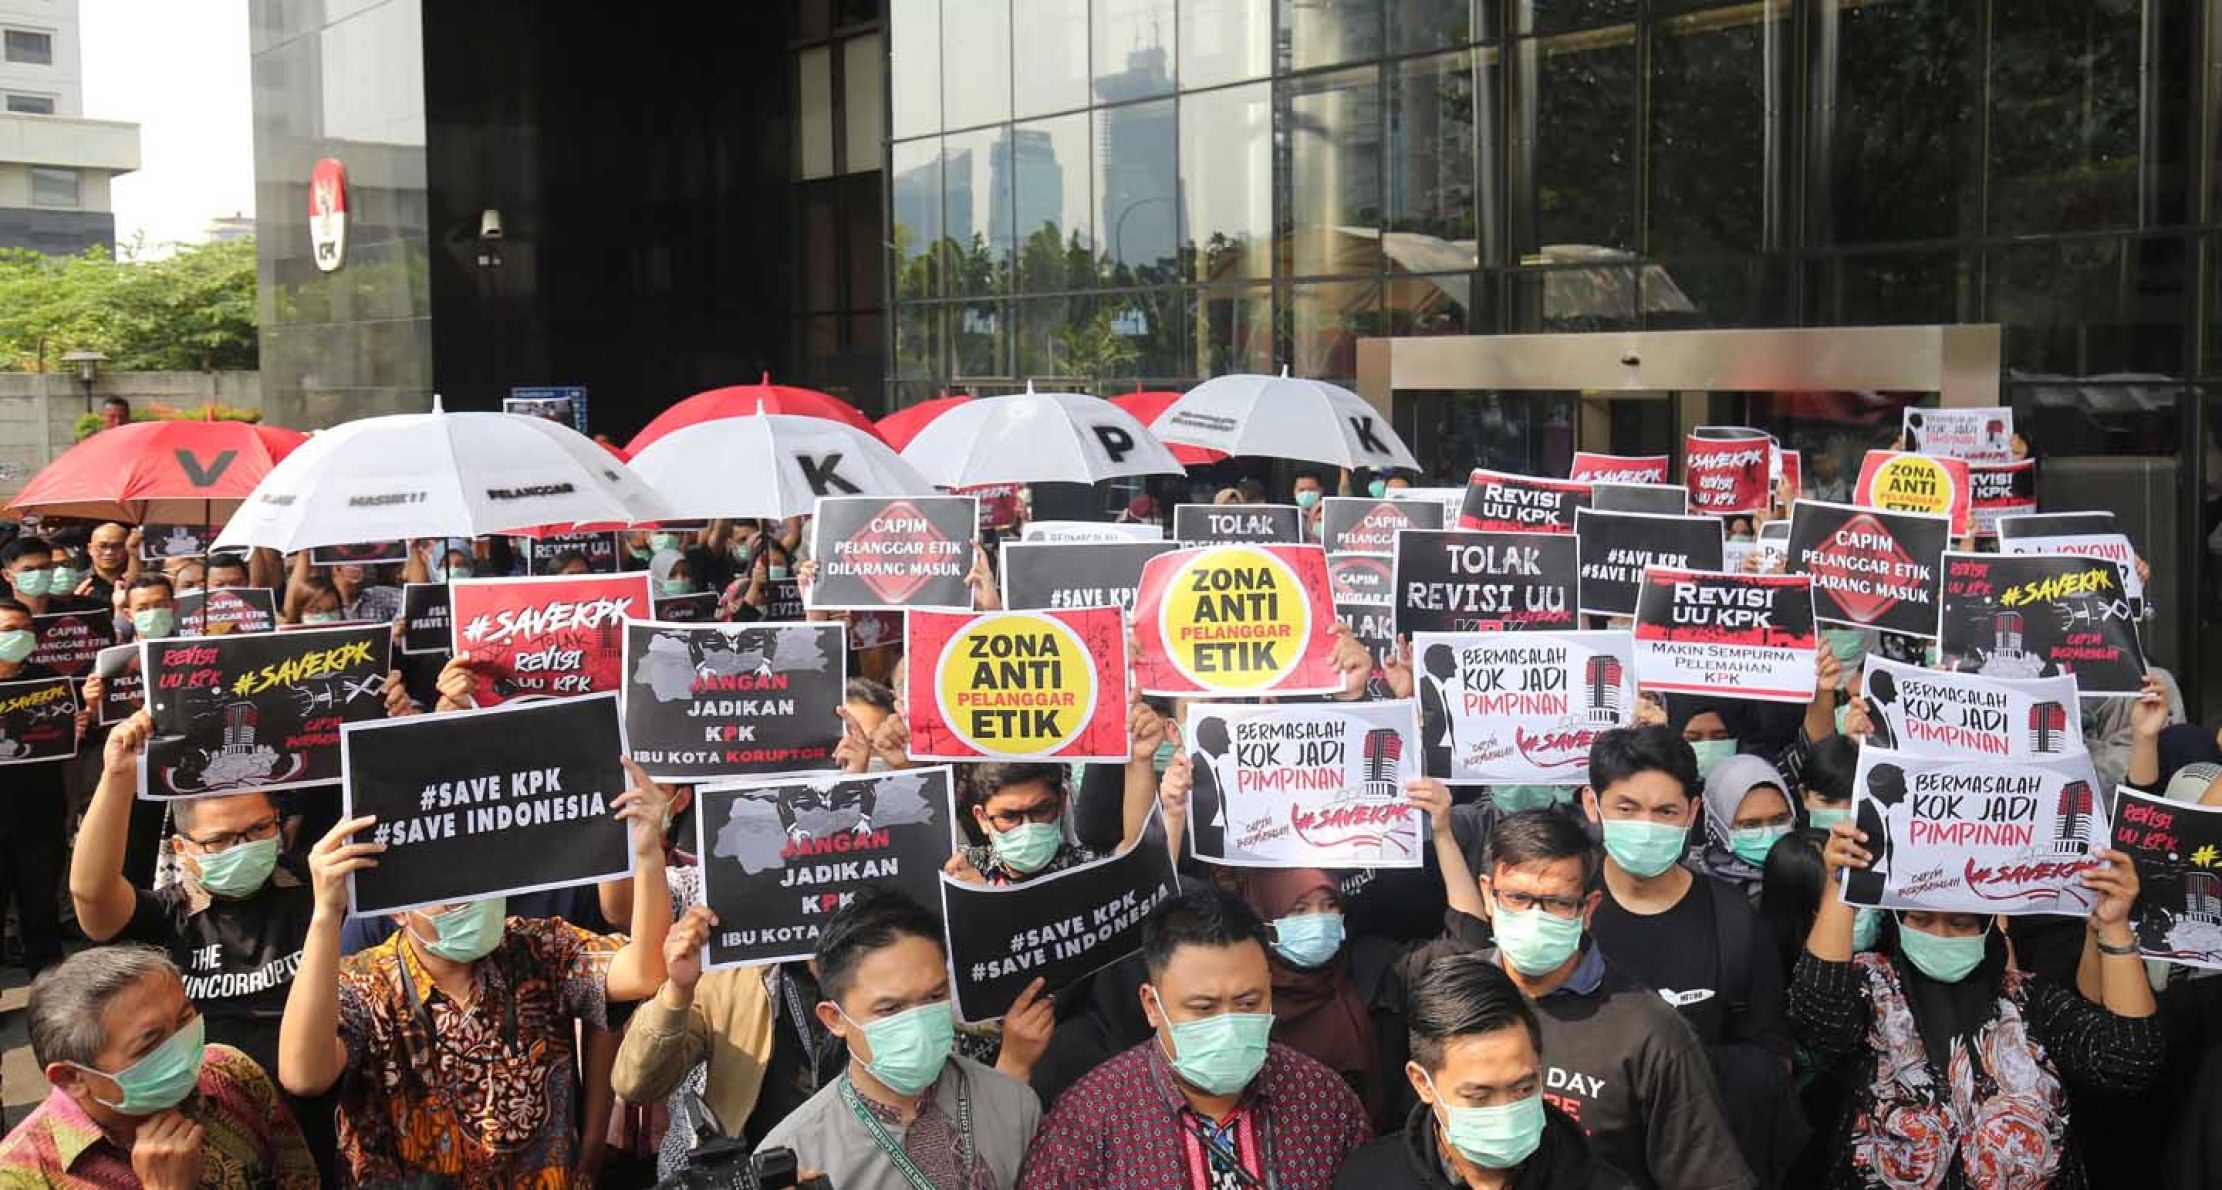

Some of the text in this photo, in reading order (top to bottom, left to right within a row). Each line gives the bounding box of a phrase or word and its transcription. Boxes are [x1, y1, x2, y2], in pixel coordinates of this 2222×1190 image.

[1091, 425, 1135, 464] P
[1349, 416, 1393, 457] K
[174, 449, 239, 487] V
[796, 453, 864, 497] K
[1890, 465, 1936, 481] ZONA
[1485, 483, 1562, 509] REVISI
[1889, 480, 1937, 496] ANTI
[871, 517, 928, 534] CAPIM
[1208, 515, 1274, 534] TOLAK
[1364, 517, 1408, 529] CAPIM
[1483, 503, 1561, 525] UU KPK
[834, 540, 962, 556] PELANGGAR ETIK
[1835, 530, 1893, 552] CAPIM
[827, 561, 962, 577] DILARANG MASUK
[1446, 543, 1543, 576] TOLAK
[1607, 548, 1688, 569] #SAVE KPK
[1801, 549, 1890, 575] PELANGGAR
[1894, 563, 1931, 581] ETIK
[1192, 567, 1276, 592] ZONA
[1339, 572, 1380, 585] CAPIM
[1581, 564, 1633, 583] #SAVE
[1050, 588, 1103, 607] #SAVE
[1406, 581, 1565, 613] REVISI UU
[1674, 582, 1776, 609] REVISI
[1875, 582, 1930, 604] MASUK
[2000, 567, 2115, 607] #SAVEKPK
[462, 595, 634, 644] #SAVEKPK
[1193, 592, 1279, 623] ANTI
[1672, 606, 1774, 629] UU KPK
[47, 626, 88, 638] CAPIM
[1180, 624, 1291, 640] PELANGGAR
[162, 646, 221, 667] REVISI
[515, 645, 583, 672] REVISI
[968, 633, 1060, 659] ZONA
[1193, 640, 1280, 673] ETIK
[1462, 647, 1567, 666] BERMASALAH
[1652, 642, 1796, 662] MAKIN SEMPURNA
[231, 640, 376, 697] #SAVEKPK
[971, 660, 1063, 690] ANTI
[1675, 656, 1773, 674] PELEMAHAN
[159, 673, 183, 691] UU
[187, 669, 223, 688] KPK
[519, 676, 594, 692] UU KPK
[689, 674, 790, 692] JANGAN
[1462, 666, 1568, 692] KOK JADI
[1704, 672, 1741, 685] KPK
[687, 698, 795, 717] JADIKAN
[957, 692, 1075, 707] PELANGGAR
[1463, 692, 1569, 717] PIMPINAN
[1902, 680, 2008, 709] BERMASALAH
[972, 709, 1063, 738] ETIK
[1902, 696, 2009, 733] KOK JADI
[705, 723, 757, 742] KPK
[1236, 721, 1347, 743] BERMASALAH
[1905, 718, 2010, 756] PIMPINAN
[633, 748, 826, 765] IBU KOTA KORUPTOR
[1236, 740, 1345, 769] KOK JADI
[420, 767, 562, 811] #SAVE KPK
[1237, 767, 1346, 794] PIMPINAN
[1915, 773, 2042, 793] BERMASALAH
[373, 791, 607, 847] #SAVE INDONESIA
[1912, 794, 2039, 822] KOK JADI
[2123, 803, 2175, 830] REVISI
[779, 829, 890, 859] JANGAN
[1908, 820, 2035, 847] PIMPINAN
[2117, 826, 2180, 852] UU KPK
[779, 857, 899, 888] JADIKAN
[801, 891, 857, 915] KPK
[970, 881, 1170, 983] #SAVE INDONESIA
[1009, 888, 1137, 953] #SAVE KPK
[721, 924, 821, 947] IBU KOTA
[191, 943, 223, 971] THE
[1546, 1067, 1606, 1099] DAY
